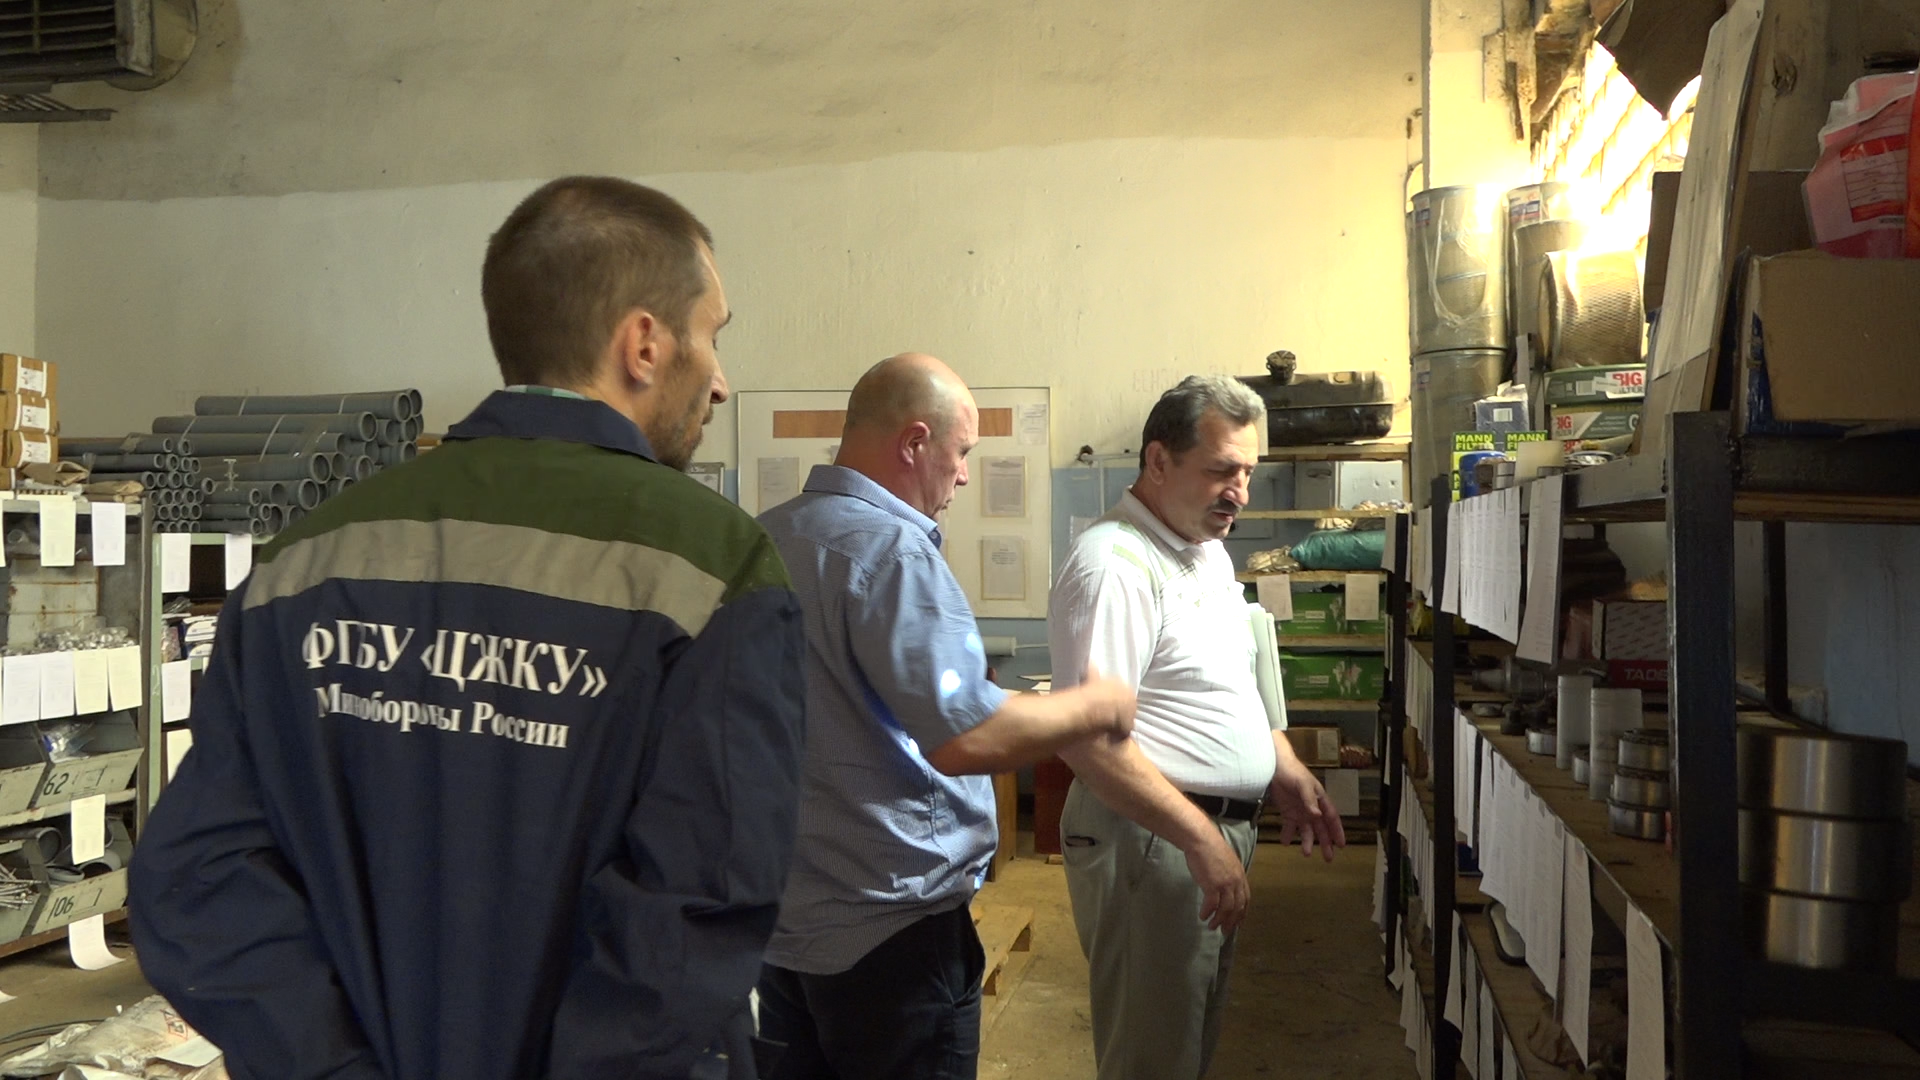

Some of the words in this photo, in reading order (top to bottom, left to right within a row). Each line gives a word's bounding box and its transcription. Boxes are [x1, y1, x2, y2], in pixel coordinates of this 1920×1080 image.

[1455, 434, 1493, 442] MANN
[1455, 442, 1495, 451] FIL
[1507, 433, 1545, 441] MANN
[302, 618, 415, 673] ФГБУ
[419, 629, 609, 699] «ЦЖКУ»
[313, 682, 462, 734] Минобороны
[470, 701, 571, 749] России
[43, 772, 70, 796] 62
[46, 895, 76, 924] 106
